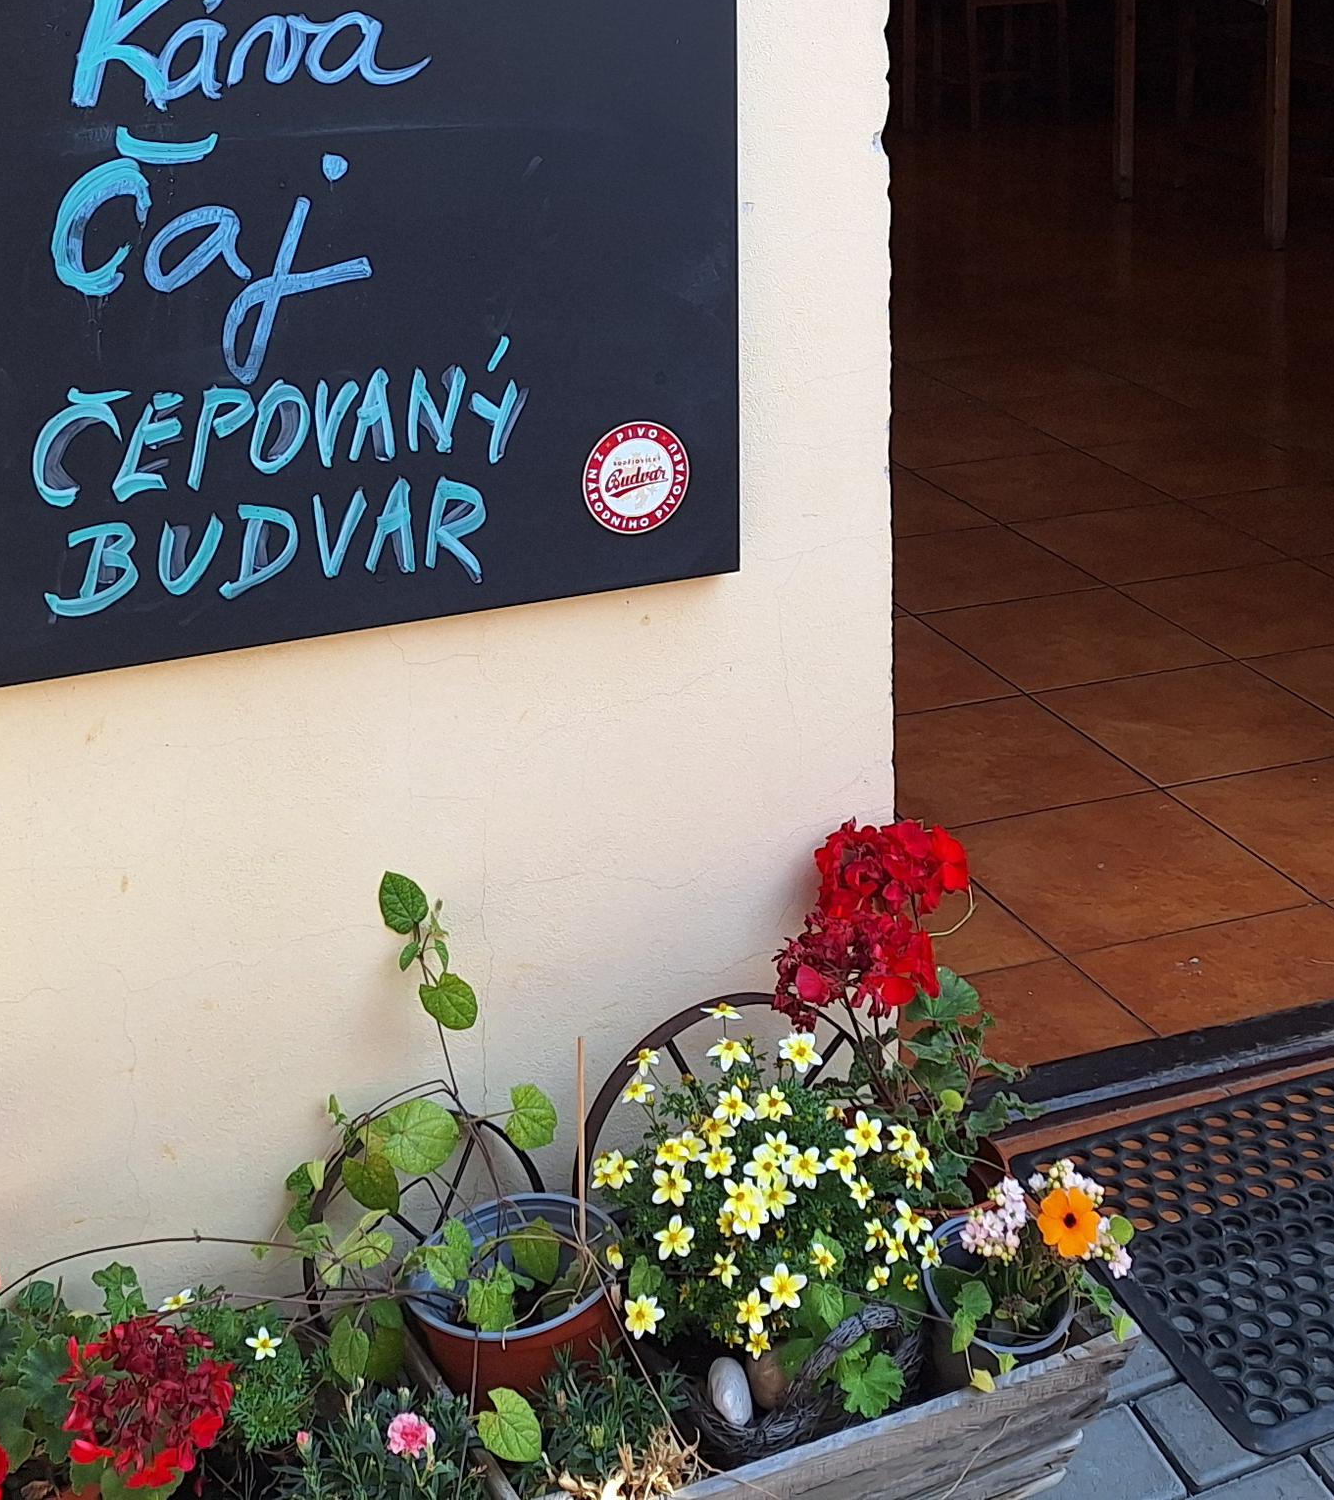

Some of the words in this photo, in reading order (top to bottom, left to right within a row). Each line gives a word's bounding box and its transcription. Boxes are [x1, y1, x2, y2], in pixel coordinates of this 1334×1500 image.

[51, 125, 372, 384] Čaj
[33, 336, 523, 506] ČEPOVANÝ
[616, 427, 658, 442] PIVO
[45, 475, 486, 617] BUDVAR
